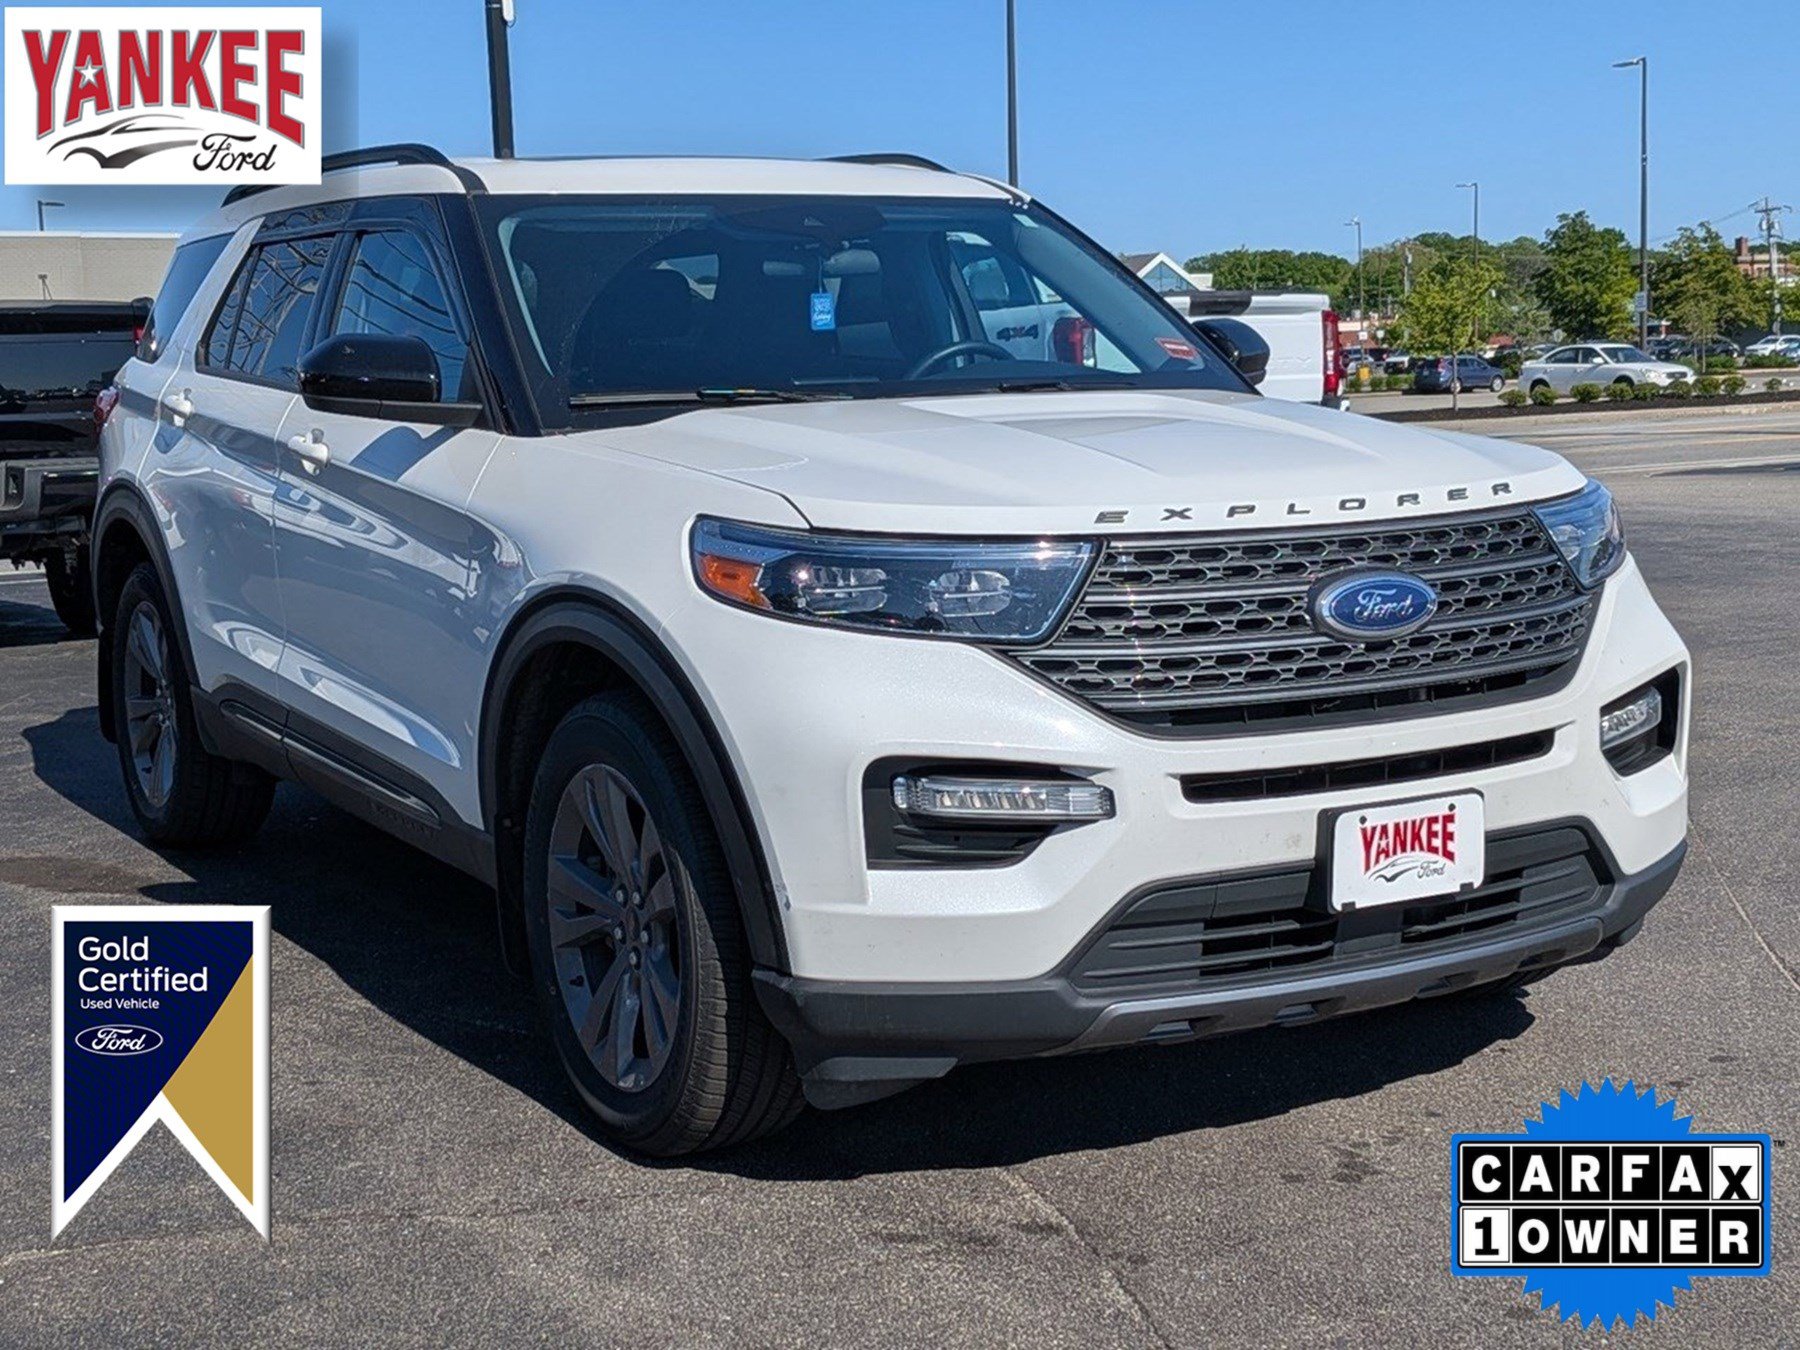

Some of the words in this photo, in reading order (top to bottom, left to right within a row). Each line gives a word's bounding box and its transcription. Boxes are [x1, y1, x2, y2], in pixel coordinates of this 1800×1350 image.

[1094, 482, 1512, 524] EXPLORER
[1353, 588, 1413, 621] Ford
[1359, 812, 1456, 875] YANKEE
[1417, 860, 1446, 879] Ford
